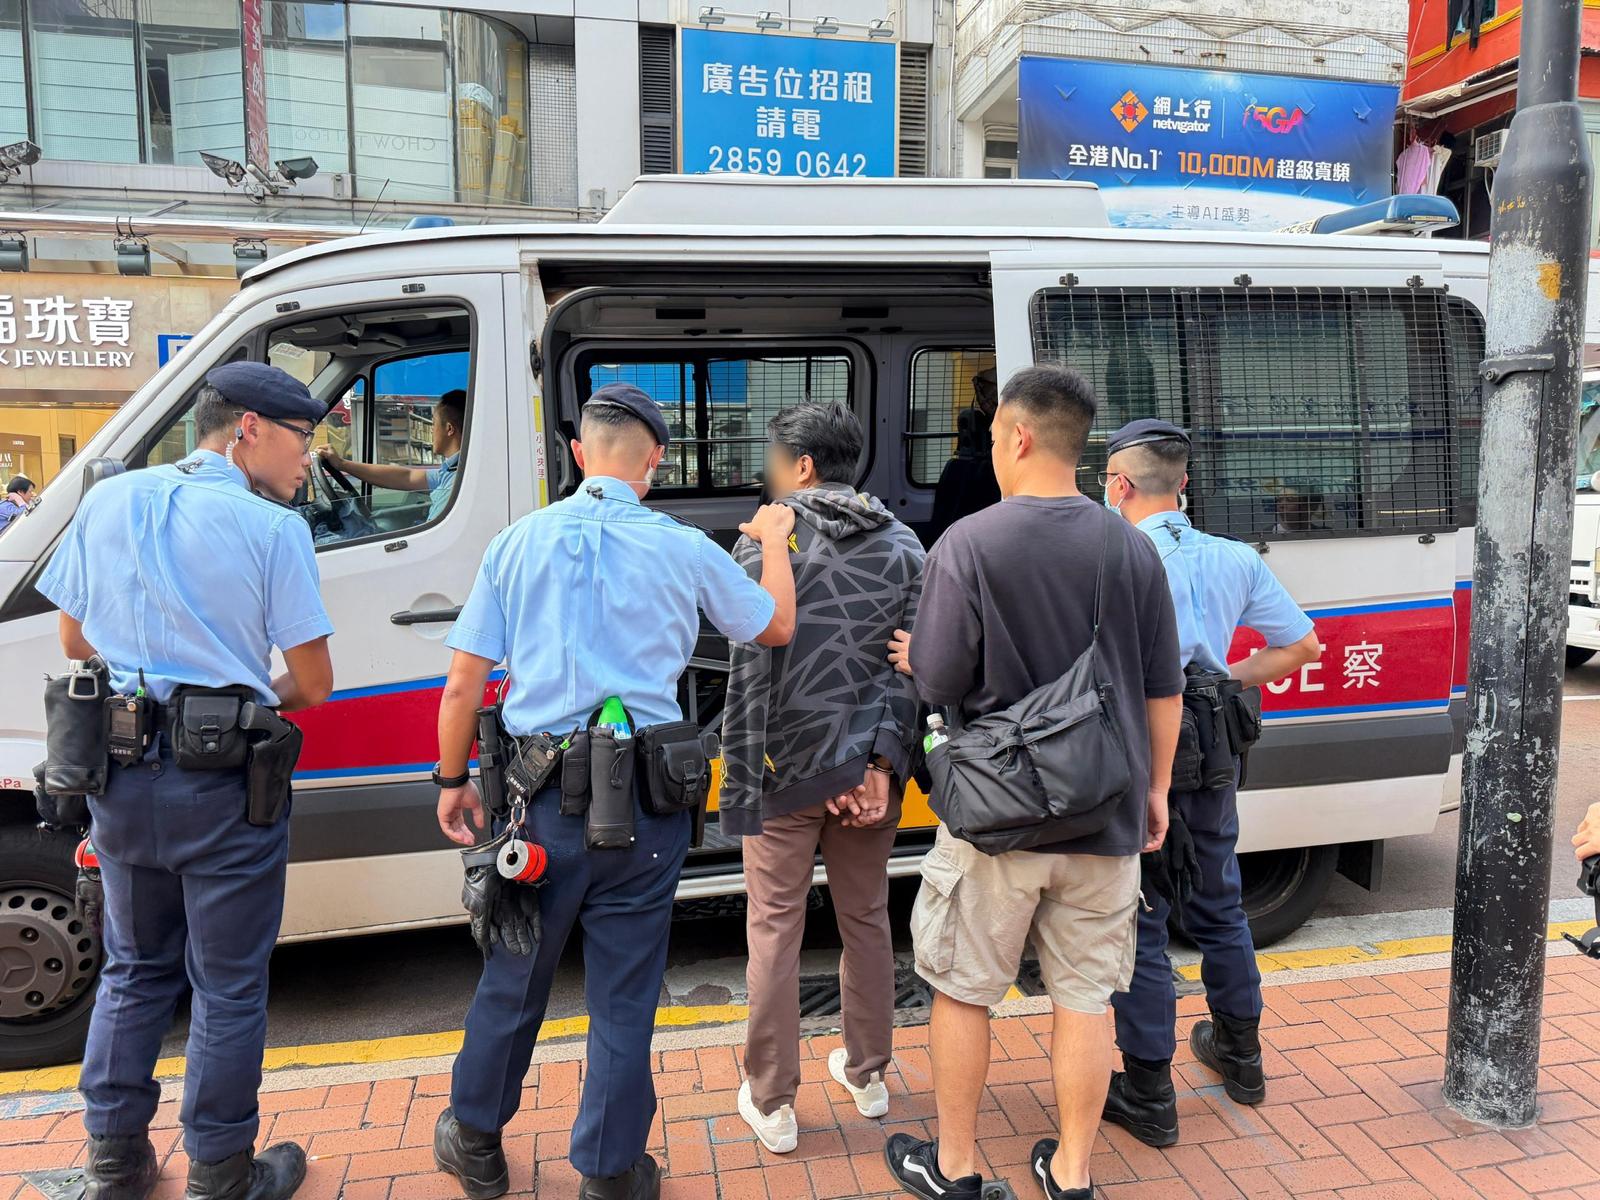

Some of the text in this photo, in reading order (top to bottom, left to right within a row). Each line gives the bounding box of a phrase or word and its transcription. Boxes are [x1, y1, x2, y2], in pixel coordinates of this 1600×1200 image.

[702, 62, 873, 104] 廣告位招租
[756, 105, 821, 141] 請電
[1153, 96, 1212, 119] 網上行
[1153, 118, 1211, 134] netvigator
[708, 145, 867, 177] 2859 0642
[13, 350, 135, 369] JEWELLERY
[1342, 640, 1384, 689] 察
